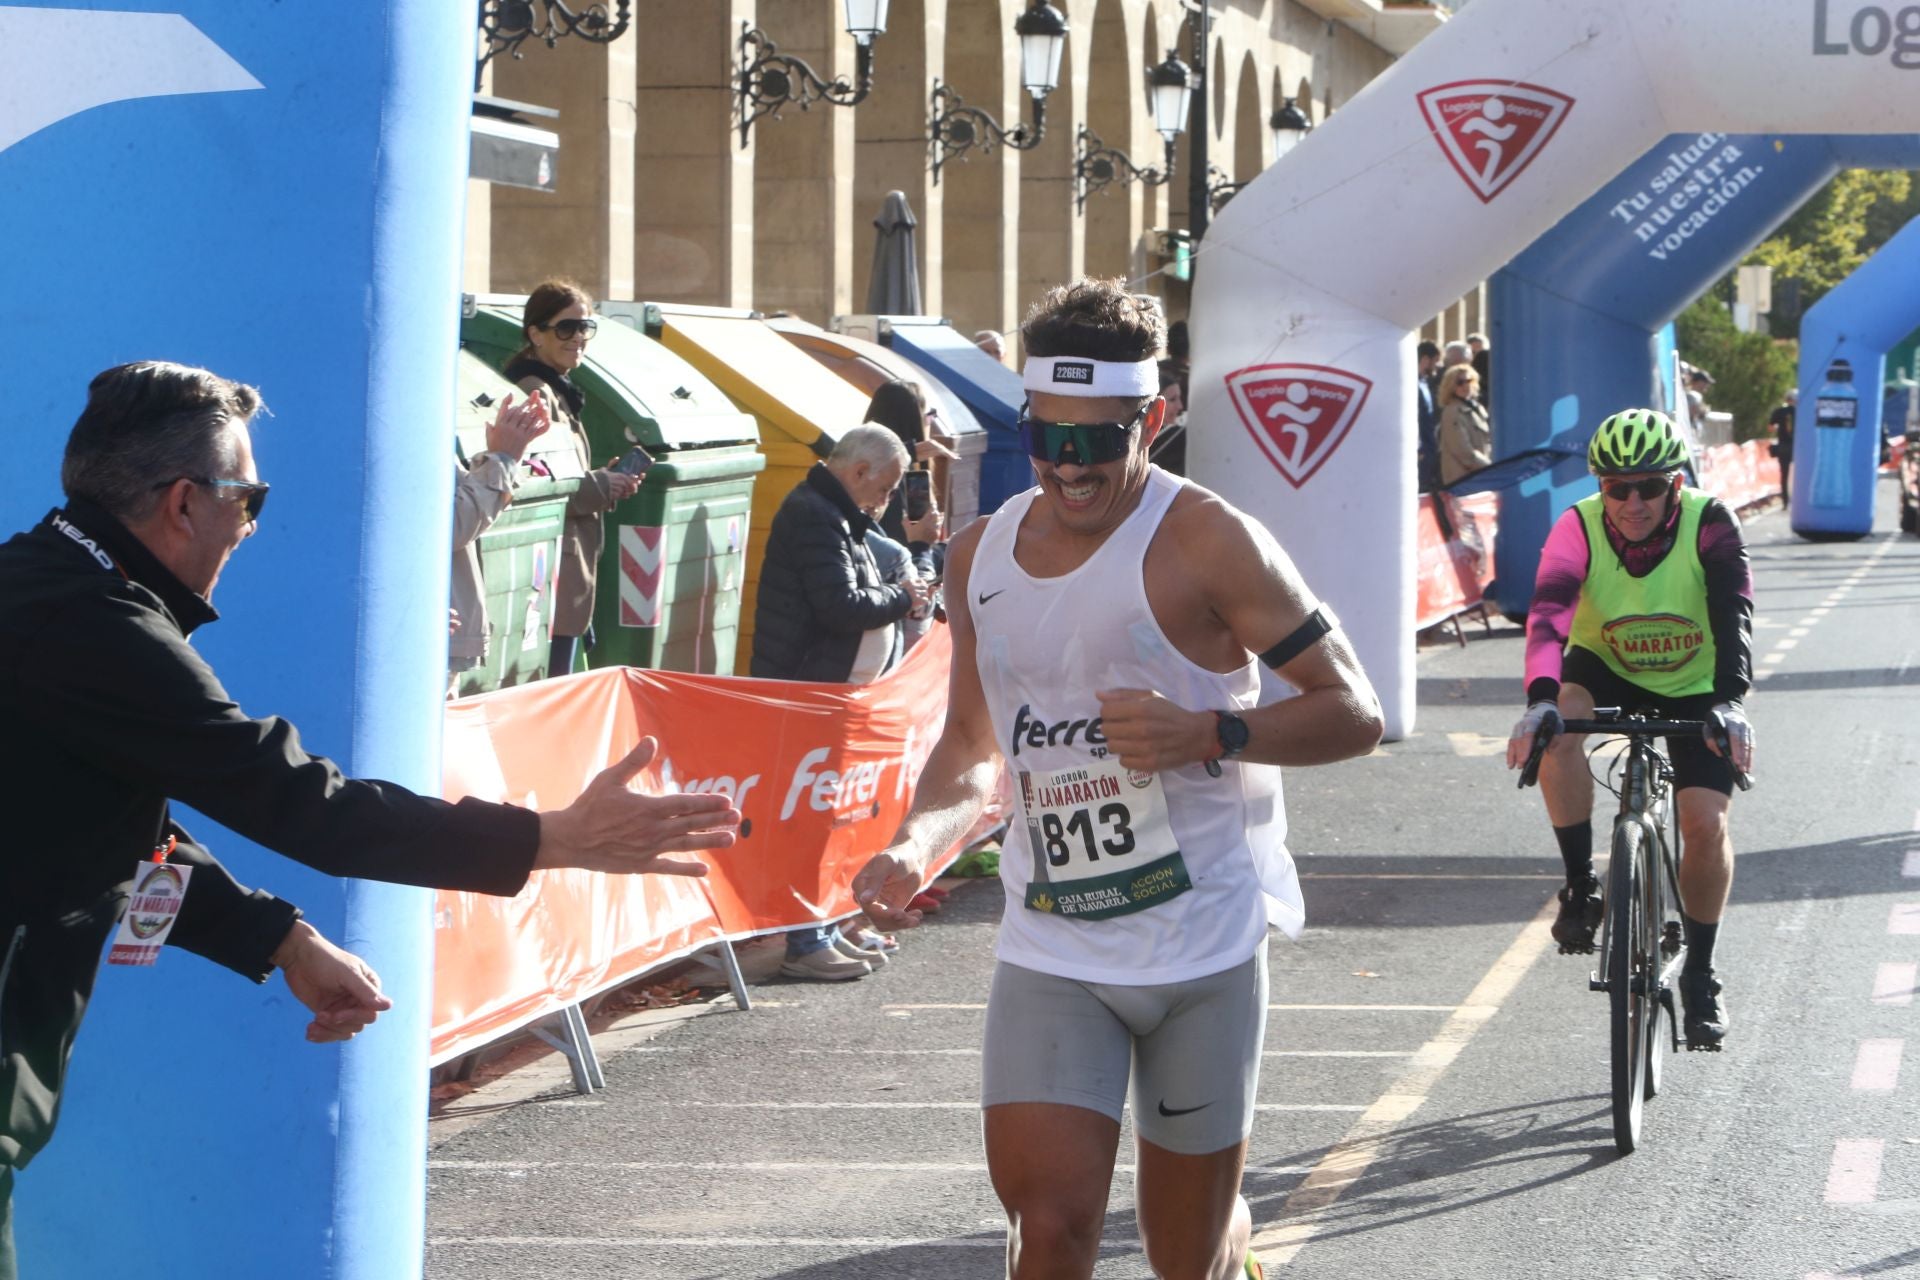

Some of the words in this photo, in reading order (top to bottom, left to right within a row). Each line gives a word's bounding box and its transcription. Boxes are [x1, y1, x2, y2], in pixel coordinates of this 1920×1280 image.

[1610, 192, 1652, 224] Tu
[1634, 145, 1743, 242] nuestra
[1649, 166, 1763, 260] vocación.
[1056, 366, 1087, 380] 226ERS
[52, 515, 114, 570] HEAD
[1012, 704, 1107, 757] ferre
[1051, 770, 1088, 786] LOGROÑO
[1053, 774, 1121, 808] MARATÓN
[1042, 802, 1136, 867] 813
[1130, 867, 1173, 890] ACCIÓN
[1133, 882, 1177, 900] SOCIAL
[1058, 893, 1084, 905] CAJA
[1084, 887, 1122, 901] RURAL
[1061, 904, 1077, 914] DE
[1079, 895, 1131, 912] NAVARRA
